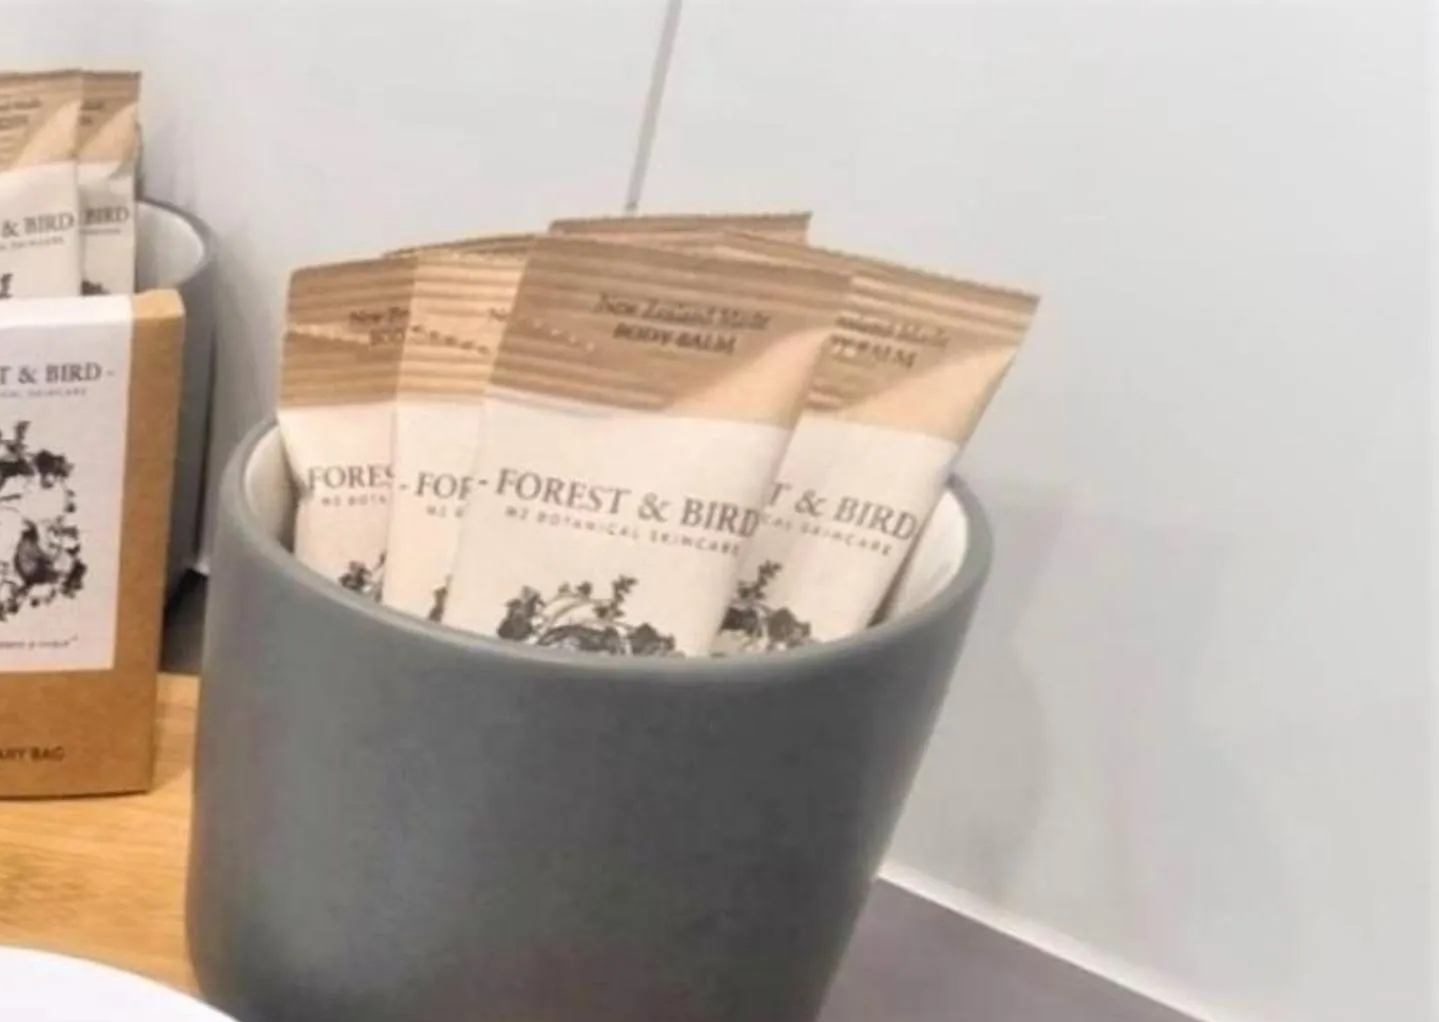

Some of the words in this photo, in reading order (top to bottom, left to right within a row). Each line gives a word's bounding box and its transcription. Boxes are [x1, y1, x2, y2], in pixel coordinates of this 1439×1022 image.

[1, 219, 20, 239] &
[23, 212, 75, 236] BIRD
[85, 206, 130, 226] BIRD
[612, 321, 670, 347] BODY
[673, 331, 738, 356] BALM
[17, 364, 39, 385] &
[45, 362, 103, 384] BIRD
[309, 464, 396, 491] FORES
[495, 467, 633, 515] FOREST
[637, 491, 672, 523] &
[679, 496, 760, 539] BIRD
[794, 488, 829, 518] &
[832, 495, 919, 542] BIRD
[535, 509, 640, 541] BOTANICAL
[649, 530, 741, 557] SKINCARE
[31, 745, 66, 762] BAG
